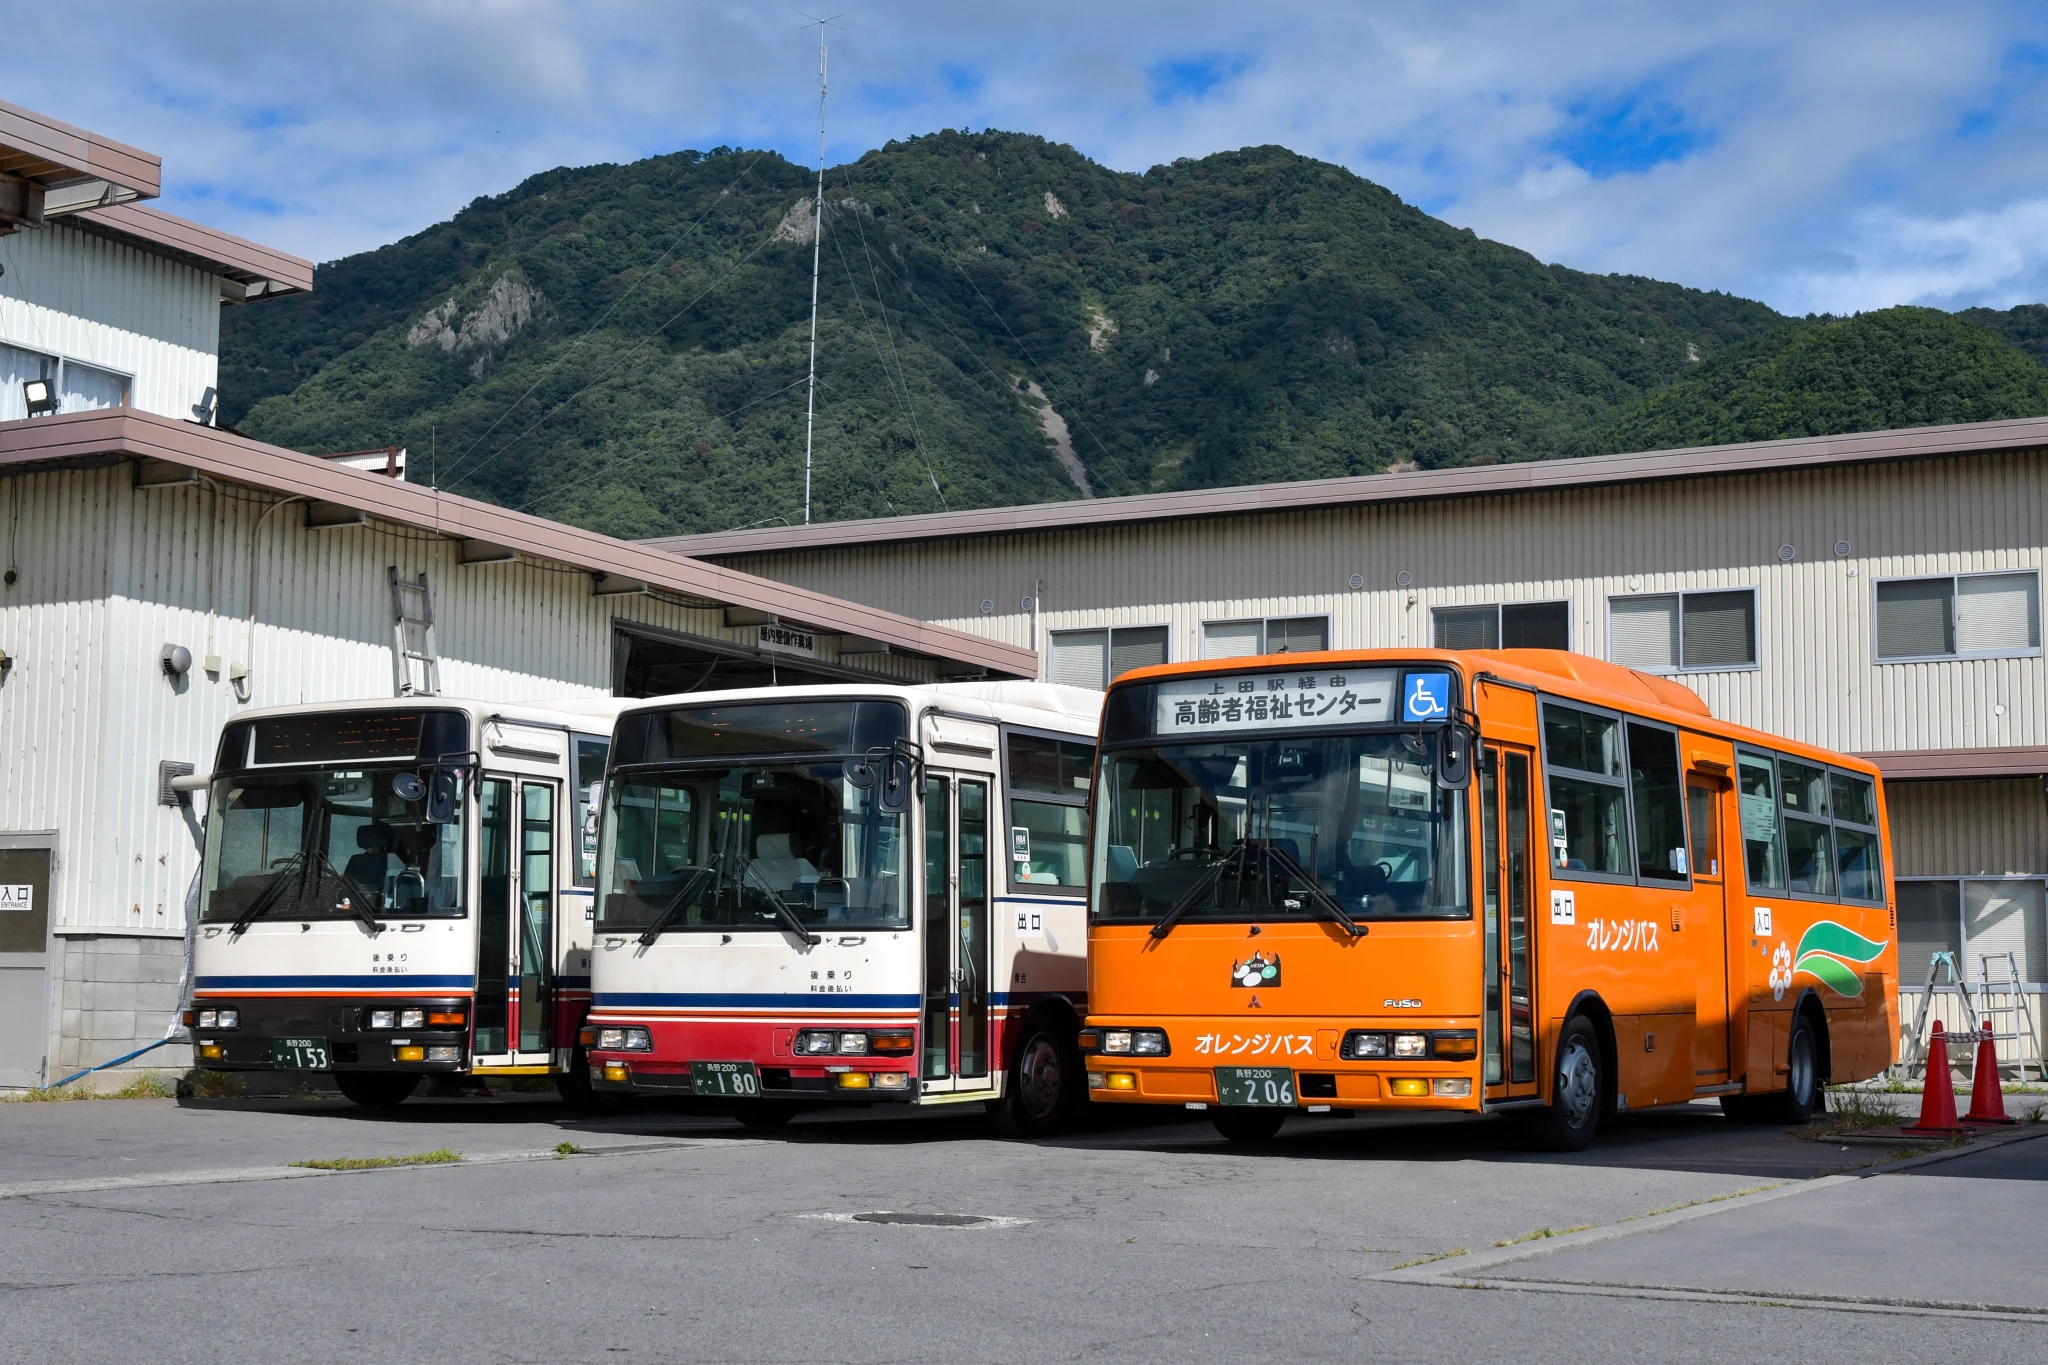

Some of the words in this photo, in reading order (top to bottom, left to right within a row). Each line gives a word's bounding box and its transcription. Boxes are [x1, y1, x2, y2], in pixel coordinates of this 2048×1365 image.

[1208, 674, 1346, 695] 上田駅経由
[1175, 690, 1382, 725] 高齢者福祉センター
[1, 886, 29, 901] 入口
[0, 901, 28, 909] ENTRANCE
[1553, 898, 1573, 917] 出口
[1018, 913, 1041, 931] 出口
[1757, 912, 1770, 931] 入口
[1586, 917, 1659, 952] オレンジバス
[810, 970, 852, 980] 後乗り
[810, 984, 852, 993] 料金後払い
[1384, 999, 1422, 1008] FUSO
[1194, 1033, 1313, 1055] オレンジバス
[1235, 1069, 1272, 1079] 長野200
